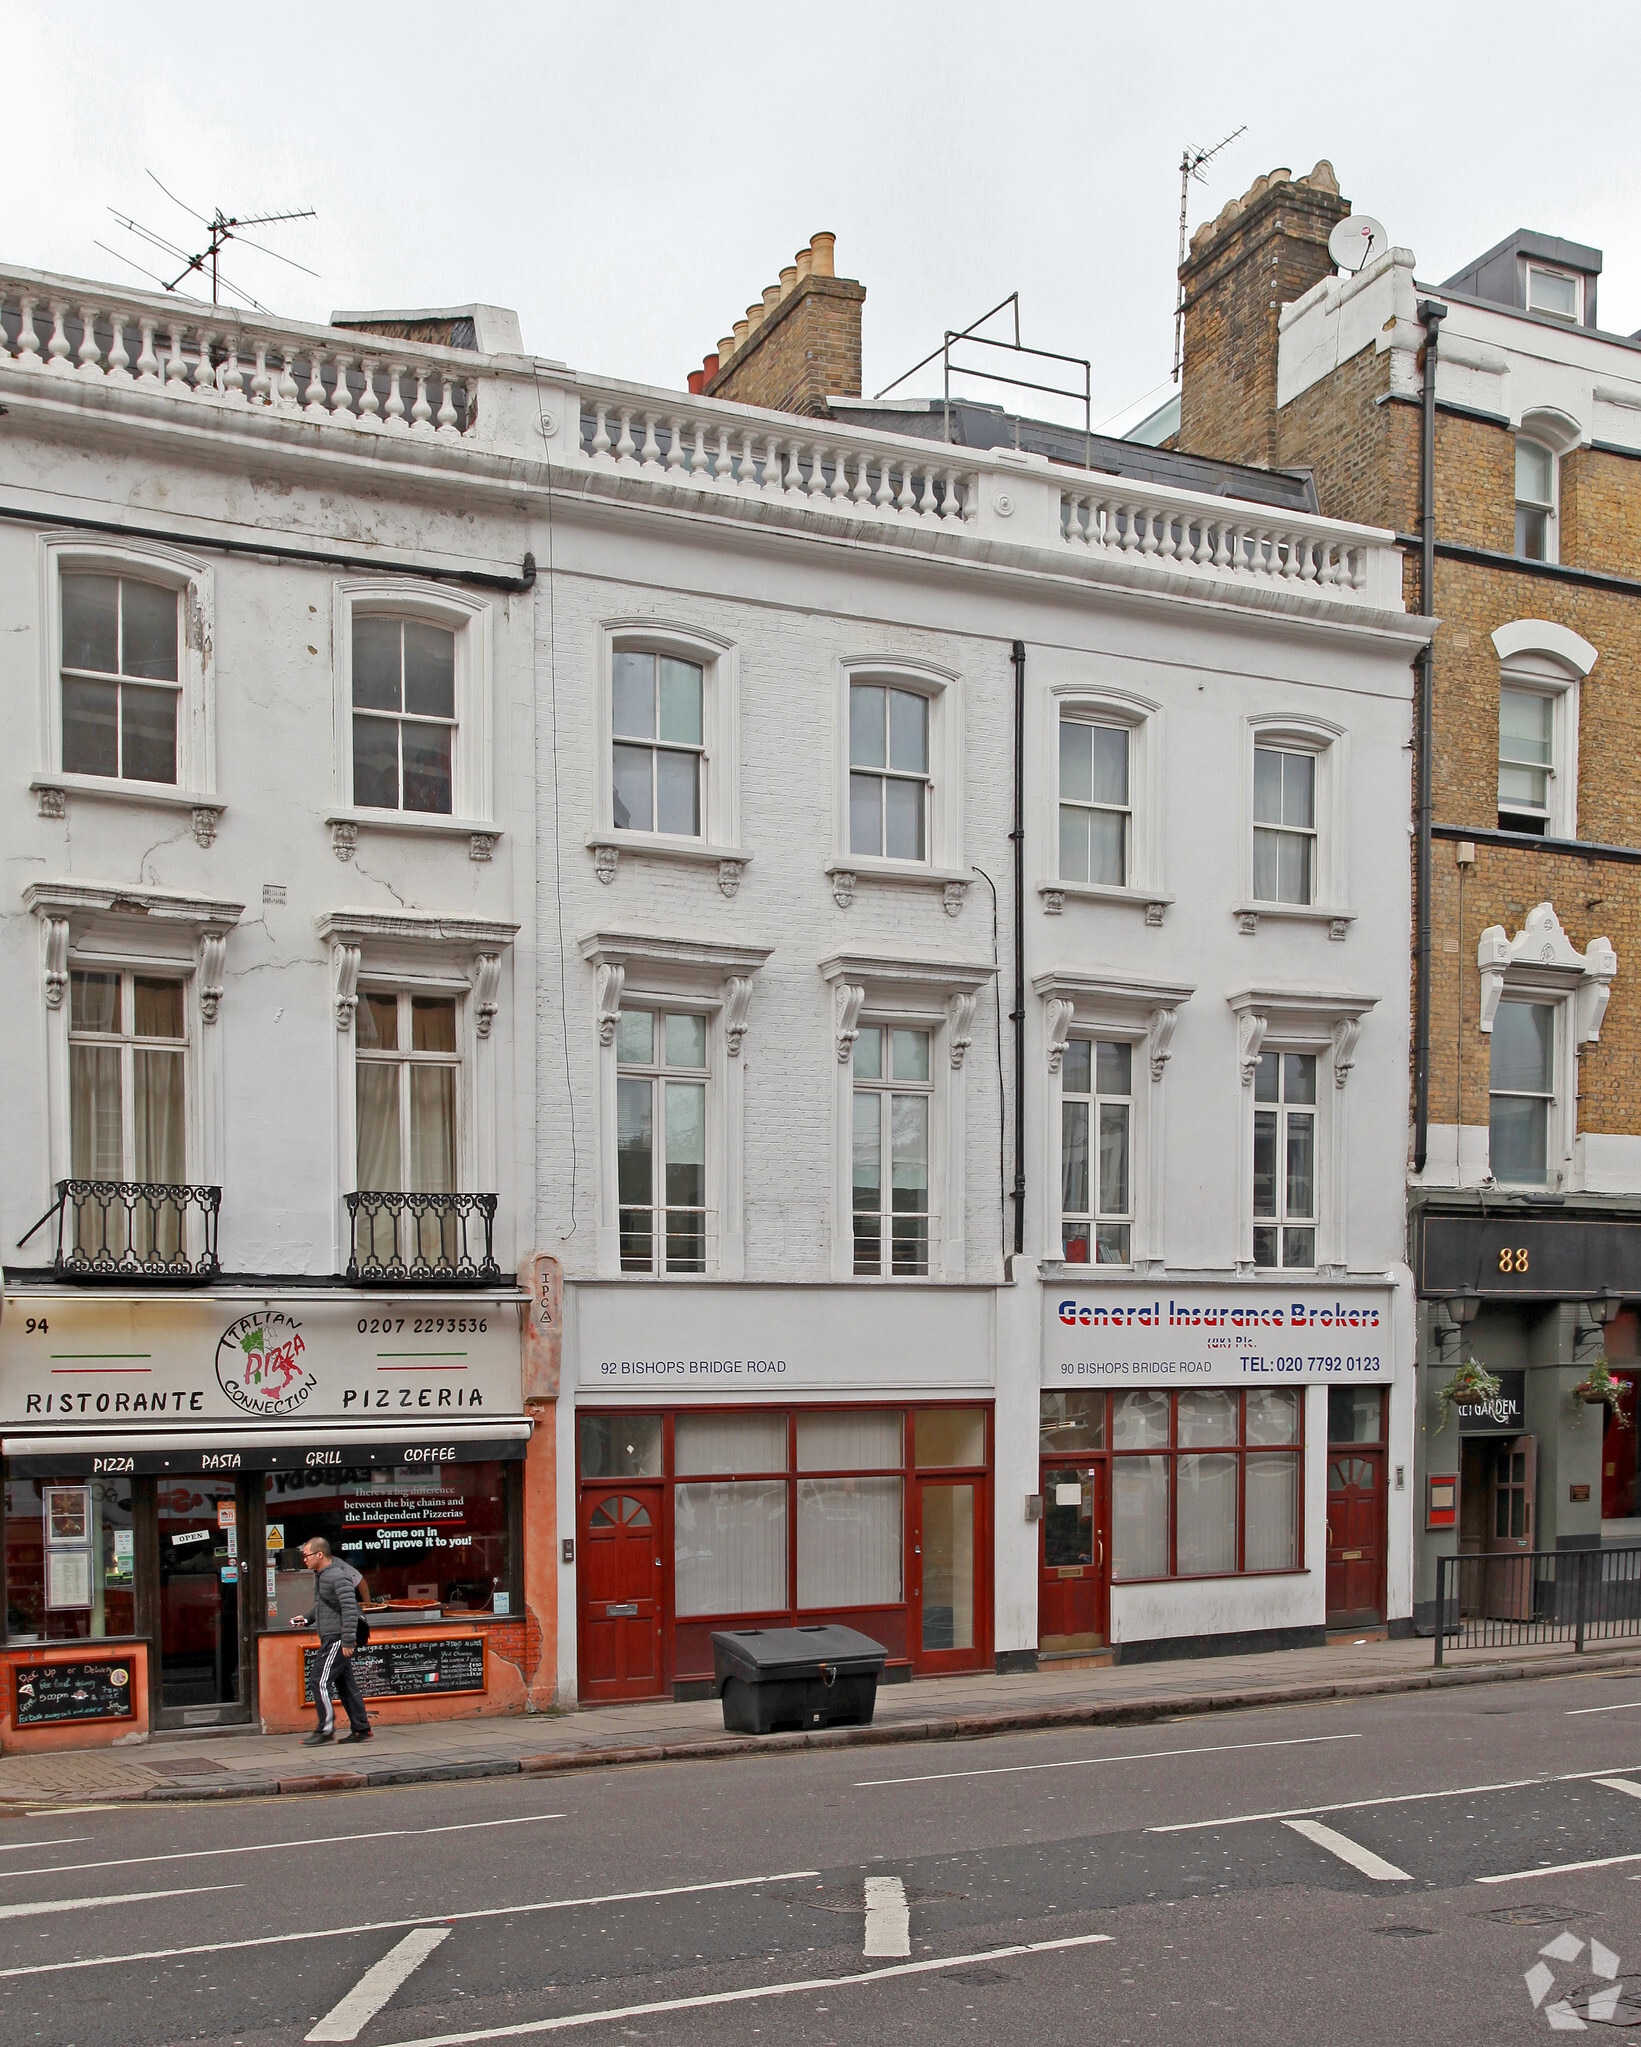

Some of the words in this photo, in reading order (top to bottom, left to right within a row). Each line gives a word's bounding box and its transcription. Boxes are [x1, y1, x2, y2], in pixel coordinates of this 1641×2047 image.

[1499, 1247, 1529, 1272] 88
[1058, 1300, 1160, 1326] General
[1169, 1300, 1284, 1327] Insurance
[1290, 1302, 1380, 1327] Brokers
[25, 1318, 49, 1334] 94
[220, 1312, 303, 1349] ITALIAN
[357, 1318, 405, 1334] 0207
[413, 1318, 488, 1333] 2293536
[243, 1333, 306, 1385] PIZZA
[1239, 1356, 1274, 1372] TEL:
[1276, 1356, 1303, 1372] 020
[1307, 1356, 1342, 1371] 7792
[1346, 1356, 1380, 1371] 0123
[600, 1362, 617, 1375] 92
[621, 1361, 685, 1374] BISHOPS
[689, 1361, 743, 1373] BRIDGE
[747, 1360, 787, 1373] ROAD
[1060, 1363, 1075, 1374] 90
[1077, 1362, 1131, 1374] BISHOPS
[1132, 1361, 1178, 1374] BRIDGE
[1179, 1361, 1212, 1373] ROAD
[224, 1373, 318, 1414] CONNECTION
[343, 1388, 483, 1408] PIZZERIA
[26, 1391, 204, 1413] RISTORANTE
[93, 1457, 134, 1473] PIZZA
[202, 1453, 241, 1469] PASTA
[305, 1450, 342, 1466] GRILL
[404, 1447, 456, 1462] COFFEE
[394, 1487, 409, 1497] big
[410, 1486, 455, 1495] difference
[344, 1500, 382, 1509] between
[384, 1499, 399, 1508] the
[401, 1498, 415, 1509] big
[416, 1497, 446, 1507] chains
[447, 1496, 464, 1506] and
[345, 1512, 363, 1521] the
[362, 1510, 421, 1522] Independent
[422, 1509, 463, 1519] Pizzerias
[179, 1532, 203, 1543] OPEN
[376, 1529, 408, 1538] Come
[410, 1529, 425, 1537] on
[427, 1527, 437, 1537] in
[341, 1540, 363, 1551] and
[365, 1539, 390, 1549] we'll
[392, 1539, 423, 1550] prove
[425, 1537, 433, 1547] it
[435, 1538, 447, 1546] to
[449, 1536, 472, 1548] you!
